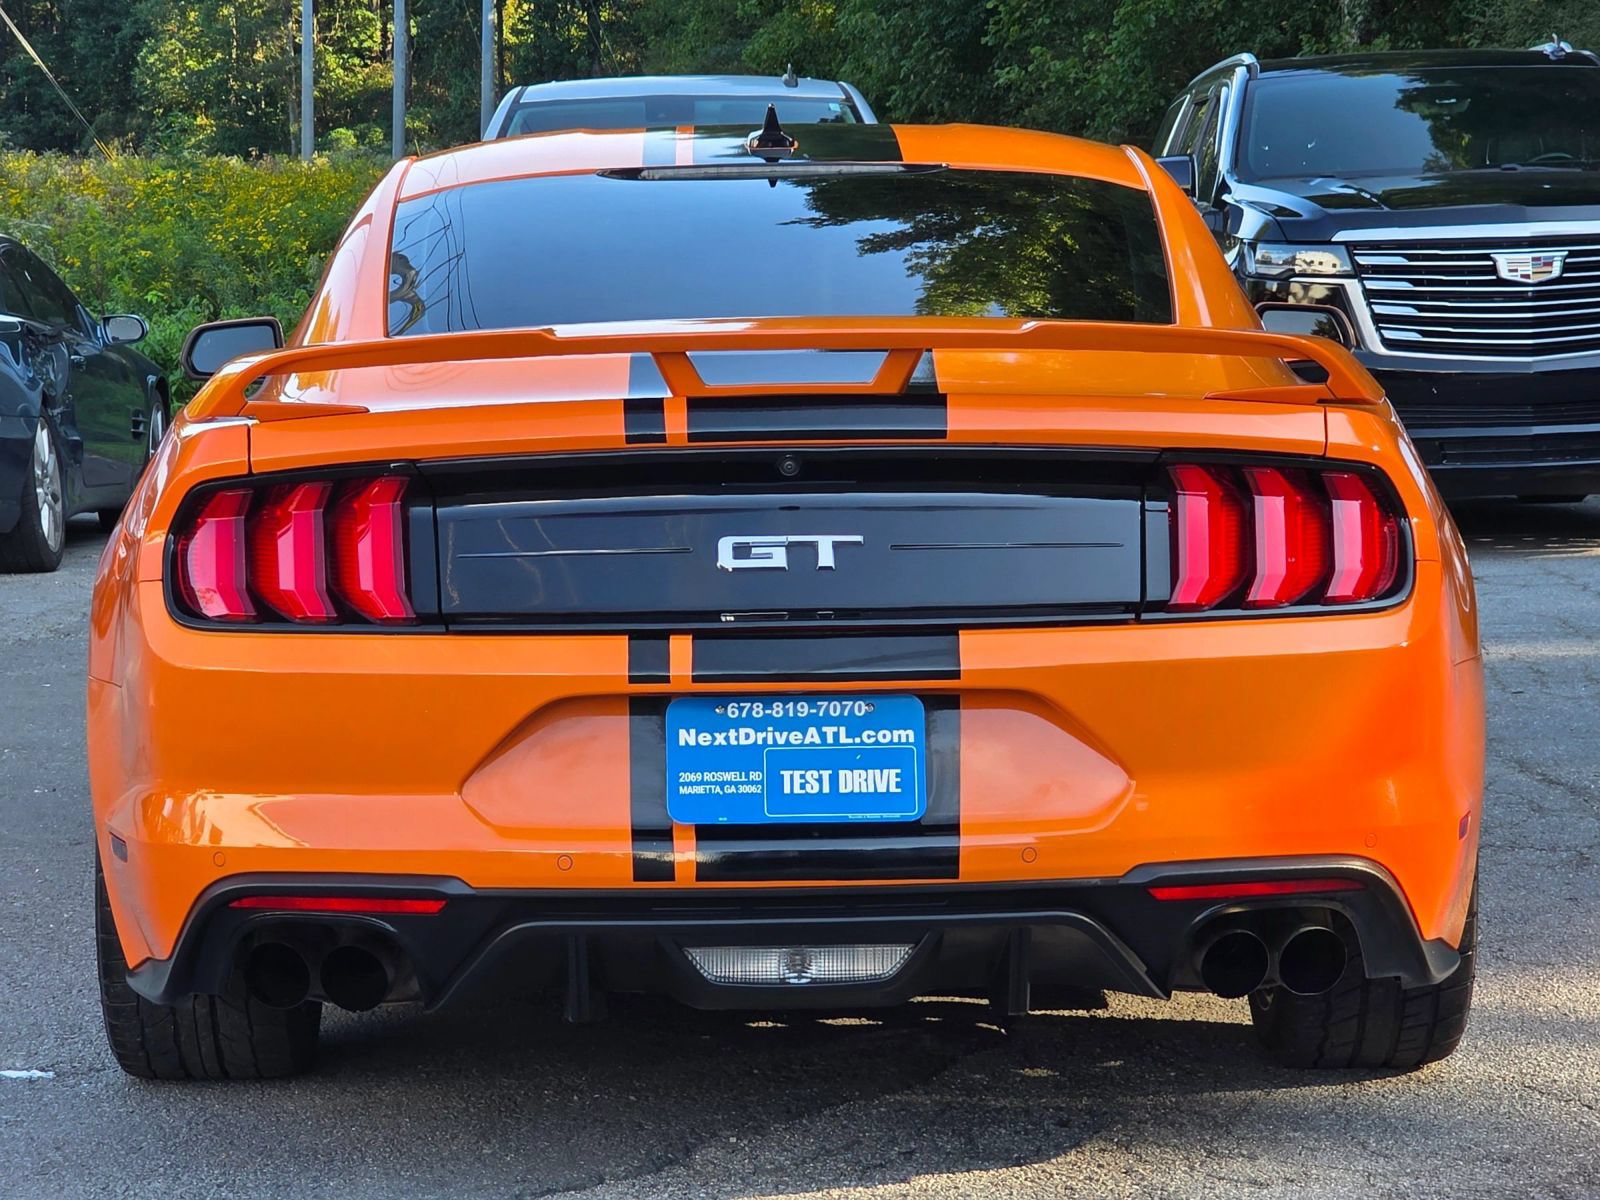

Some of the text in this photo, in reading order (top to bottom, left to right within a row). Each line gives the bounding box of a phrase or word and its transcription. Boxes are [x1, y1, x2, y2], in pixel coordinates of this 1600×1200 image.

[717, 535, 864, 571] GT
[726, 700, 866, 719] 678-819-7070
[678, 726, 915, 747] NextDriveATL.com
[678, 771, 763, 783] 2069 ROSWELL RD
[780, 768, 902, 794] TEST DRIVE
[679, 784, 762, 795] MARIETTA, GA 30062
